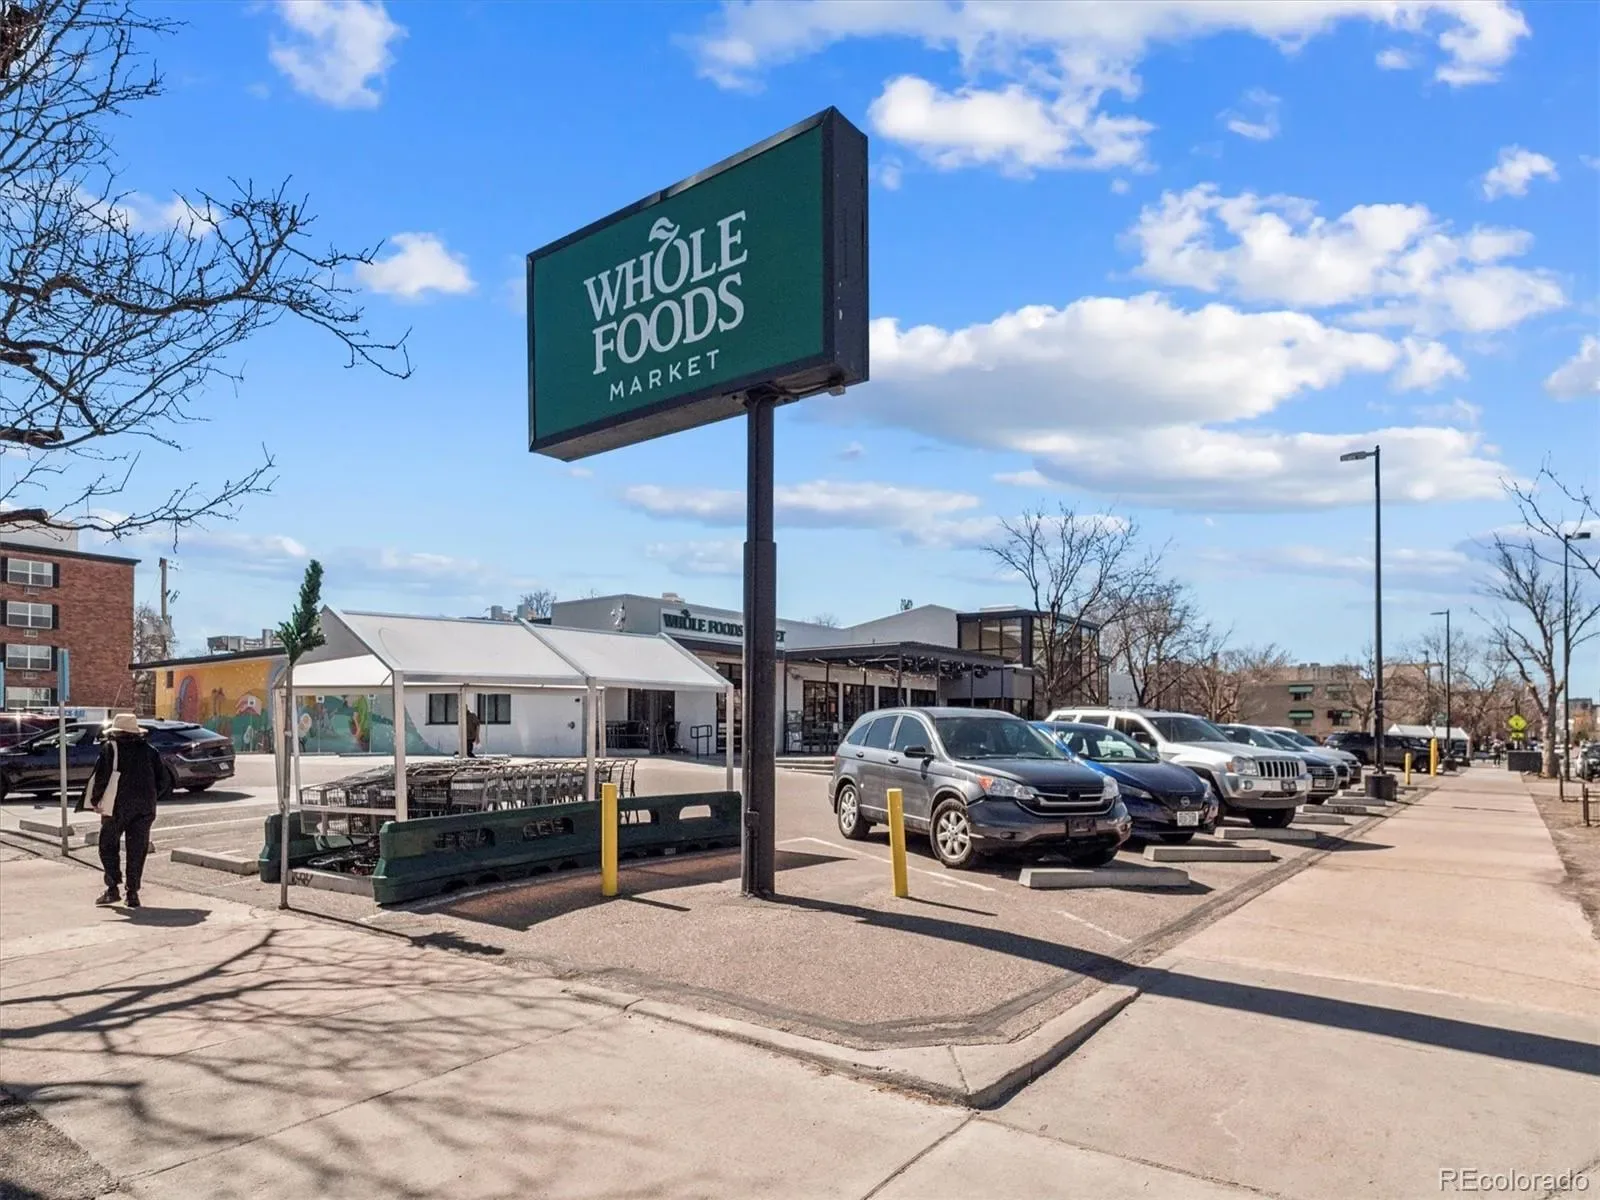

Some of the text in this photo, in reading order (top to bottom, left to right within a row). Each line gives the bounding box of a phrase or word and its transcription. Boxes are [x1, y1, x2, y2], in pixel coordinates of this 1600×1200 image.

[583, 209, 748, 322] WHOLE
[592, 272, 745, 375] FOODS
[609, 349, 720, 401] MARKET
[663, 609, 744, 637] WHOLE FOODS
